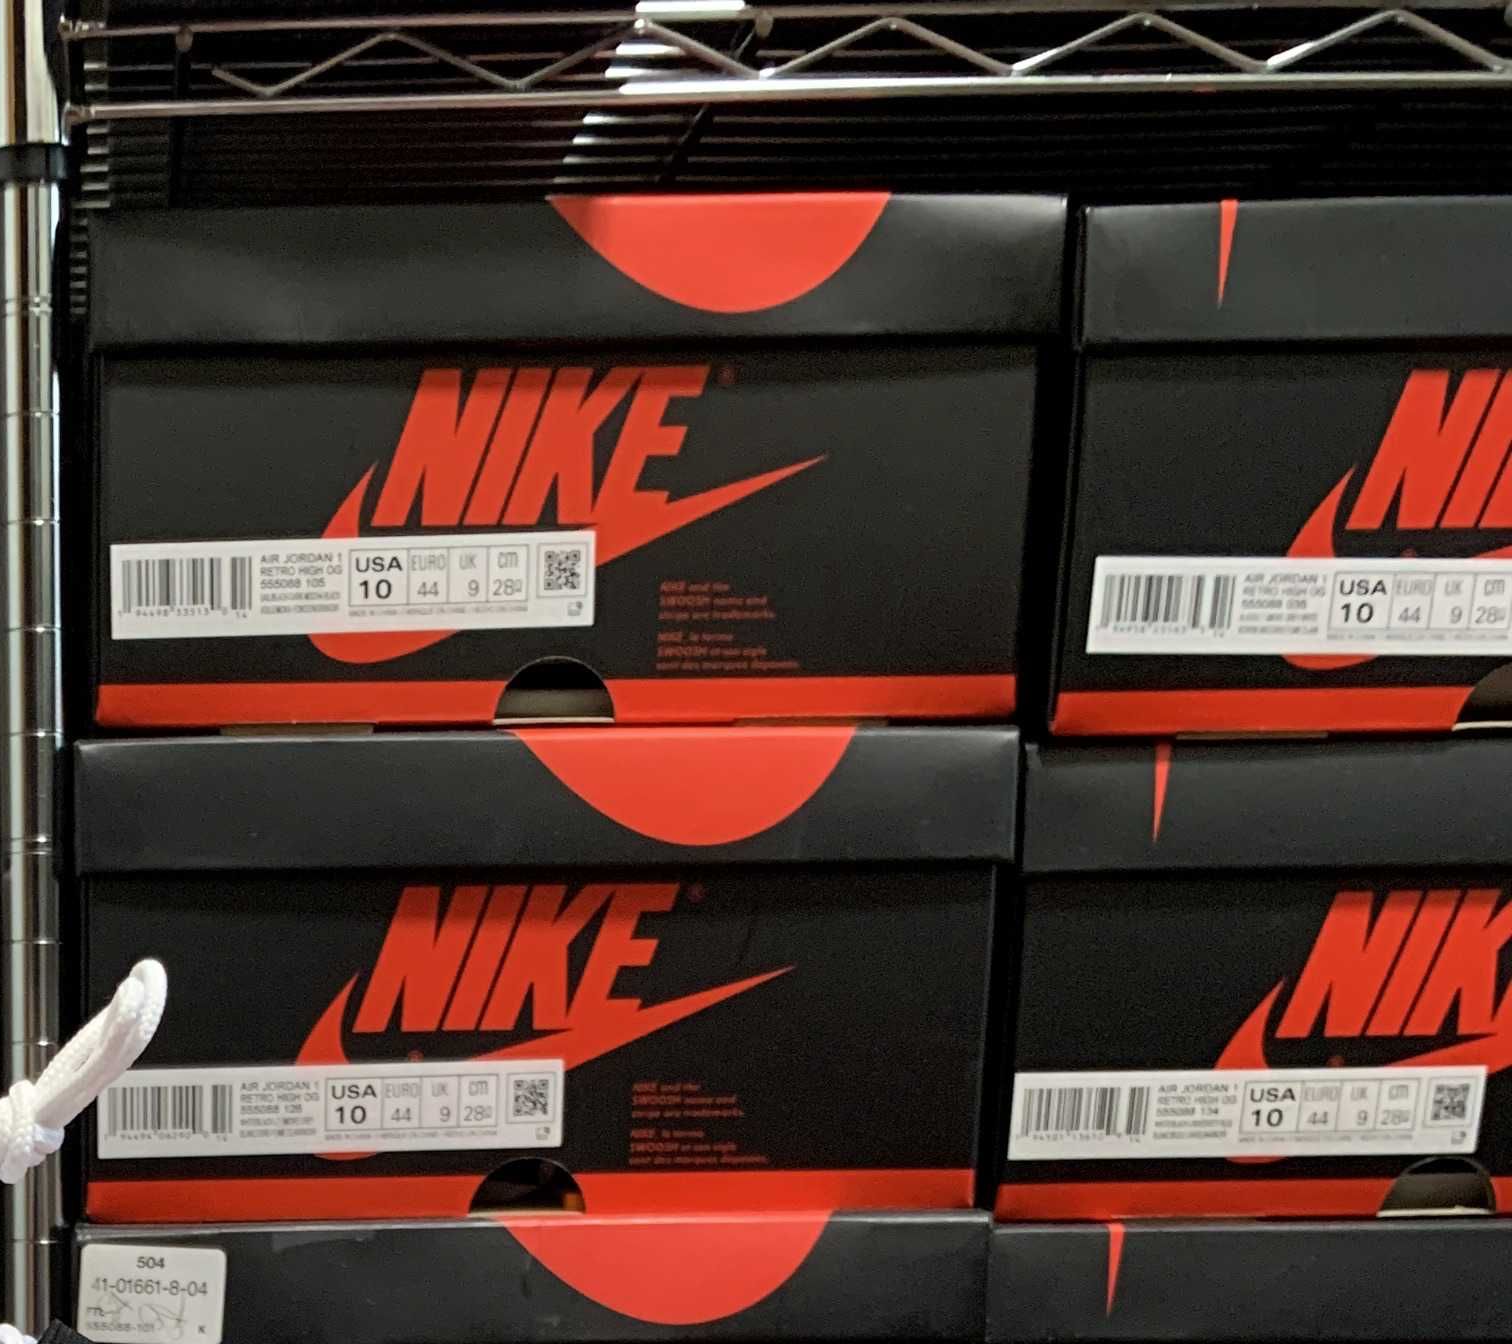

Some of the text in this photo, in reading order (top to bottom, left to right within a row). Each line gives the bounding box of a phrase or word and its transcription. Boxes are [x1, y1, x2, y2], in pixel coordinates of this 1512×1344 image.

[371, 364, 711, 527] NIKE
[1345, 368, 1512, 530] NI
[260, 553, 279, 564] AIR
[284, 552, 333, 563] JORDAN
[355, 555, 403, 573] USA
[411, 554, 446, 571] EURO
[459, 553, 477, 570] UK
[260, 564, 342, 576] RETRO HIGH OG
[359, 579, 392, 599] 10
[417, 581, 439, 597] 44
[467, 580, 479, 597] 9
[1339, 579, 1386, 596] USA
[1395, 580, 1433, 596] EURO
[1341, 602, 1374, 623] 10
[1398, 606, 1421, 623] 44
[1450, 606, 1463, 624] 9
[351, 883, 680, 1032] NIKE
[1275, 888, 1512, 1039] NIK
[331, 1084, 377, 1100] USA
[385, 1082, 419, 1099] EURO
[432, 1081, 448, 1098] UK
[1249, 1087, 1296, 1103] USA
[1304, 1086, 1339, 1101] EURO
[1350, 1086, 1368, 1100] UK
[335, 1105, 367, 1124] 10
[391, 1108, 412, 1122] 44
[439, 1107, 451, 1123] 9
[1251, 1108, 1284, 1127] 10
[1307, 1110, 1329, 1125] 44
[1357, 1110, 1368, 1126] 9
[136, 1256, 165, 1269] 504
[91, 1277, 208, 1297] 41-01661-8-04
